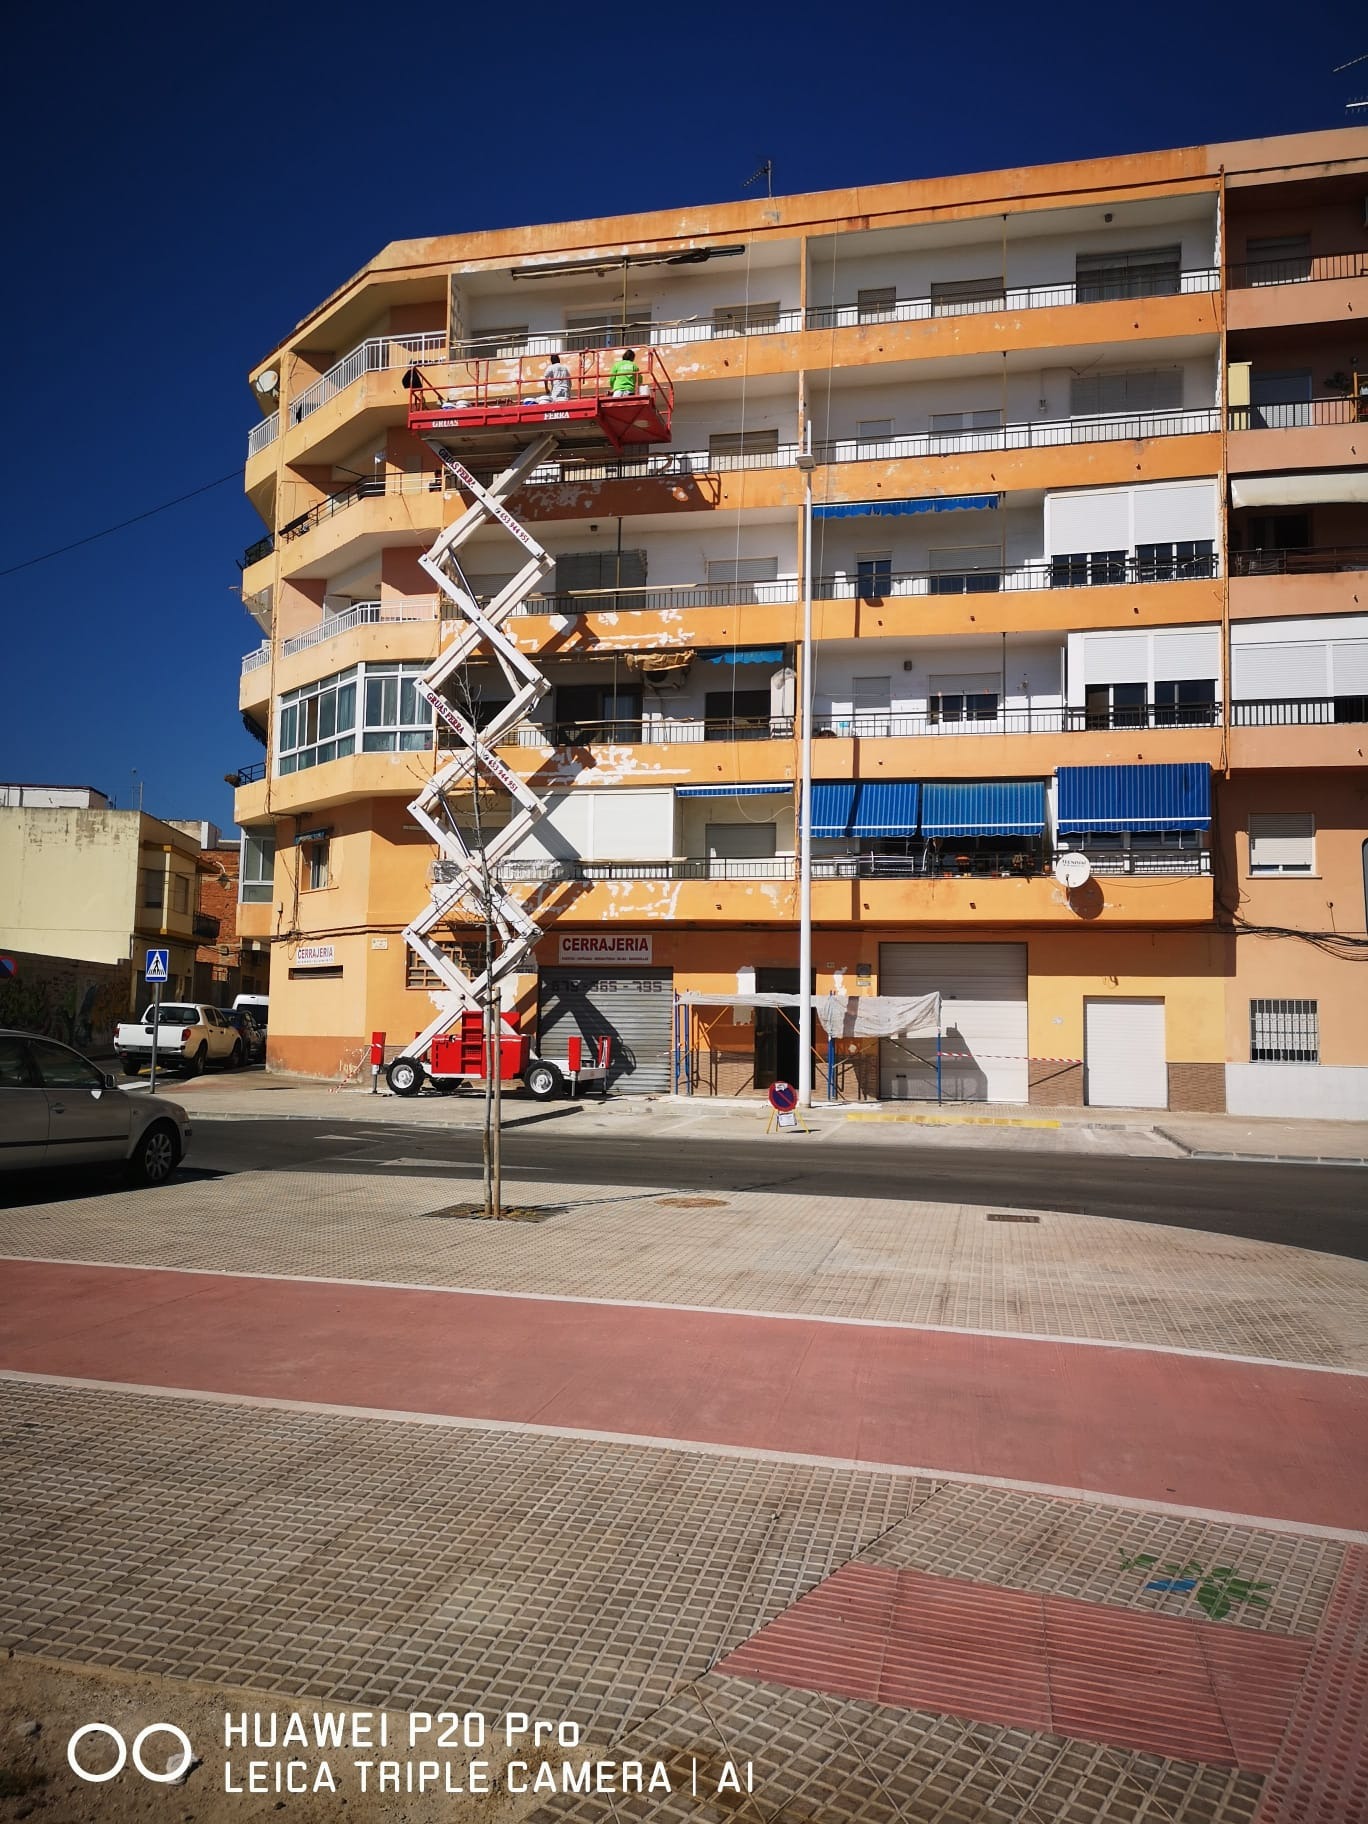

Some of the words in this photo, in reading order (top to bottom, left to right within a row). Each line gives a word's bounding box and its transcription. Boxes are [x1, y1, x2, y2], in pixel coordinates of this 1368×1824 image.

[432, 419, 459, 428] GRUAS
[439, 448, 461, 471] GRUAS
[500, 512, 511, 524] 653
[510, 521, 520, 534] 944
[519, 532, 529, 543] 951
[427, 692, 448, 715] GRUAS
[445, 711, 465, 734] FERRA
[488, 759, 499, 771] 653
[498, 769, 509, 782] 944
[507, 780, 518, 792] 951
[562, 938, 649, 952] CERRAJERIA
[297, 946, 333, 960] CERRAJERIA
